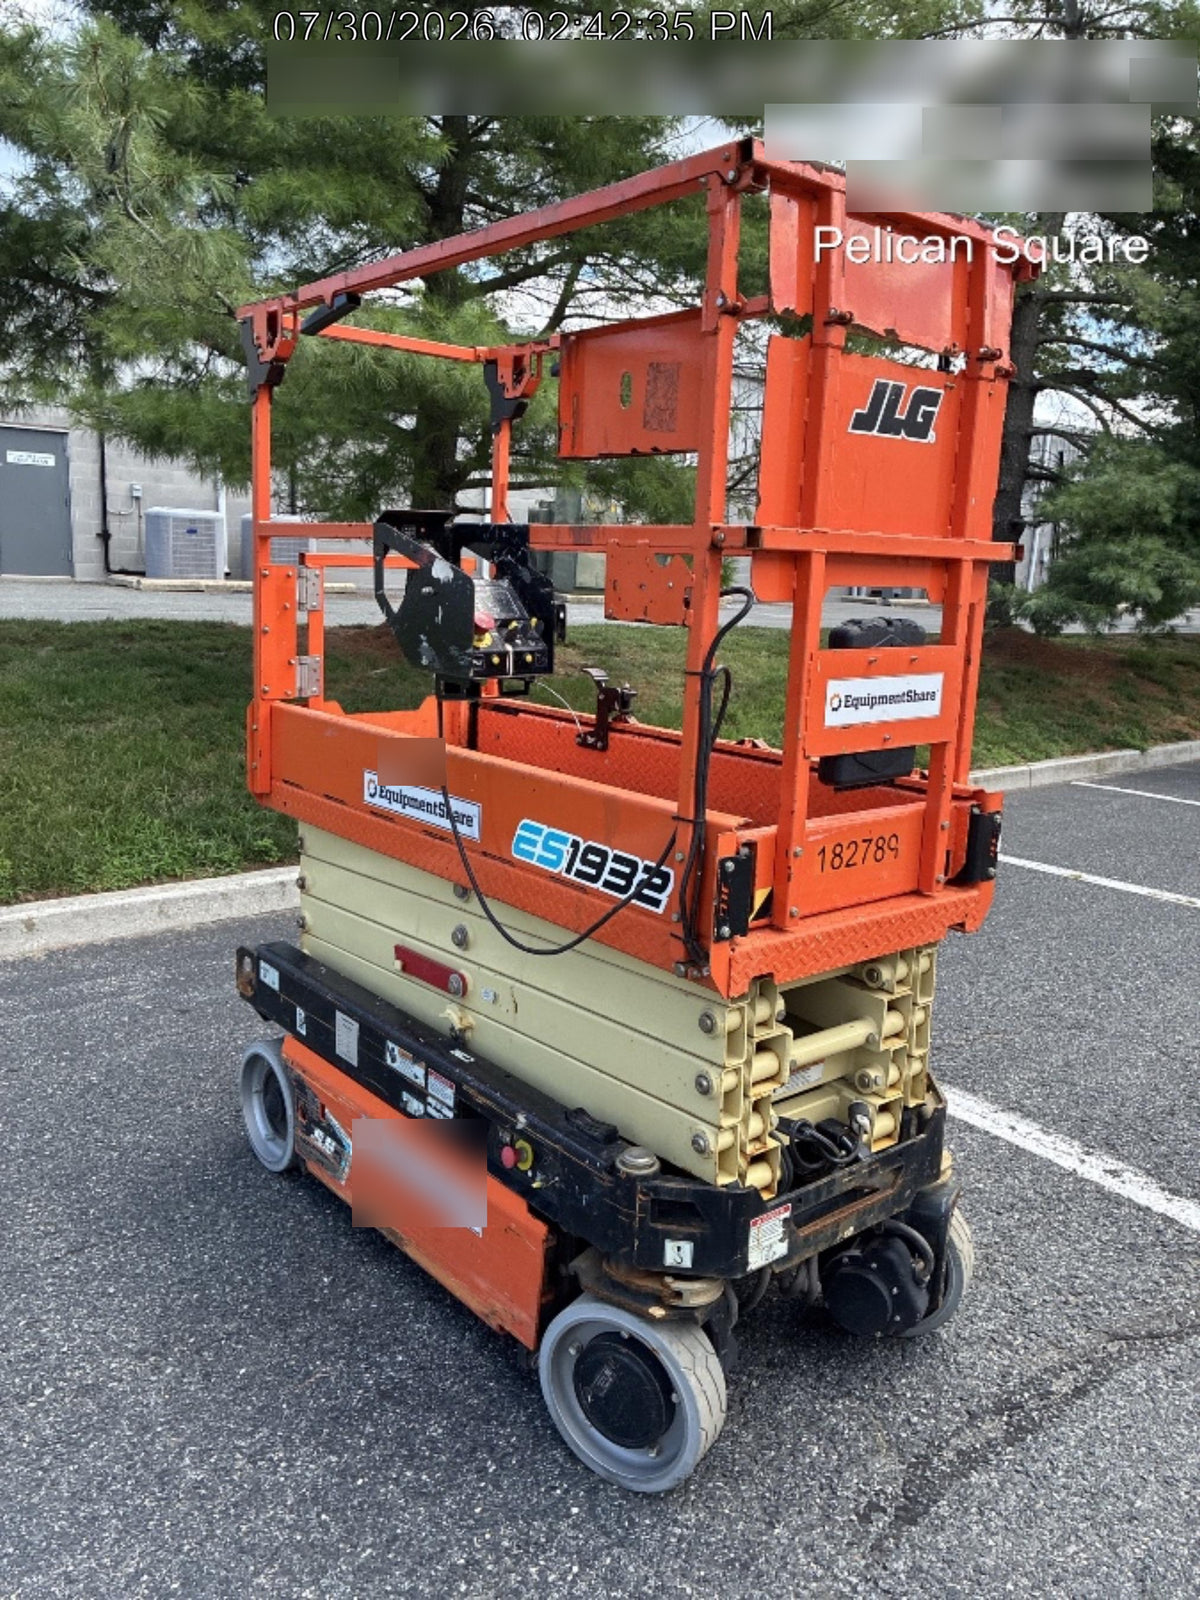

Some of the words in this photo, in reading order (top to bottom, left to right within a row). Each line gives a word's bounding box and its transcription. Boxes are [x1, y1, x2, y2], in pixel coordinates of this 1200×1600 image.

[849, 379, 944, 442] JLG
[844, 690, 937, 709] EquipmentShare
[513, 820, 673, 912] ES1932
[818, 833, 899, 873] 182789
